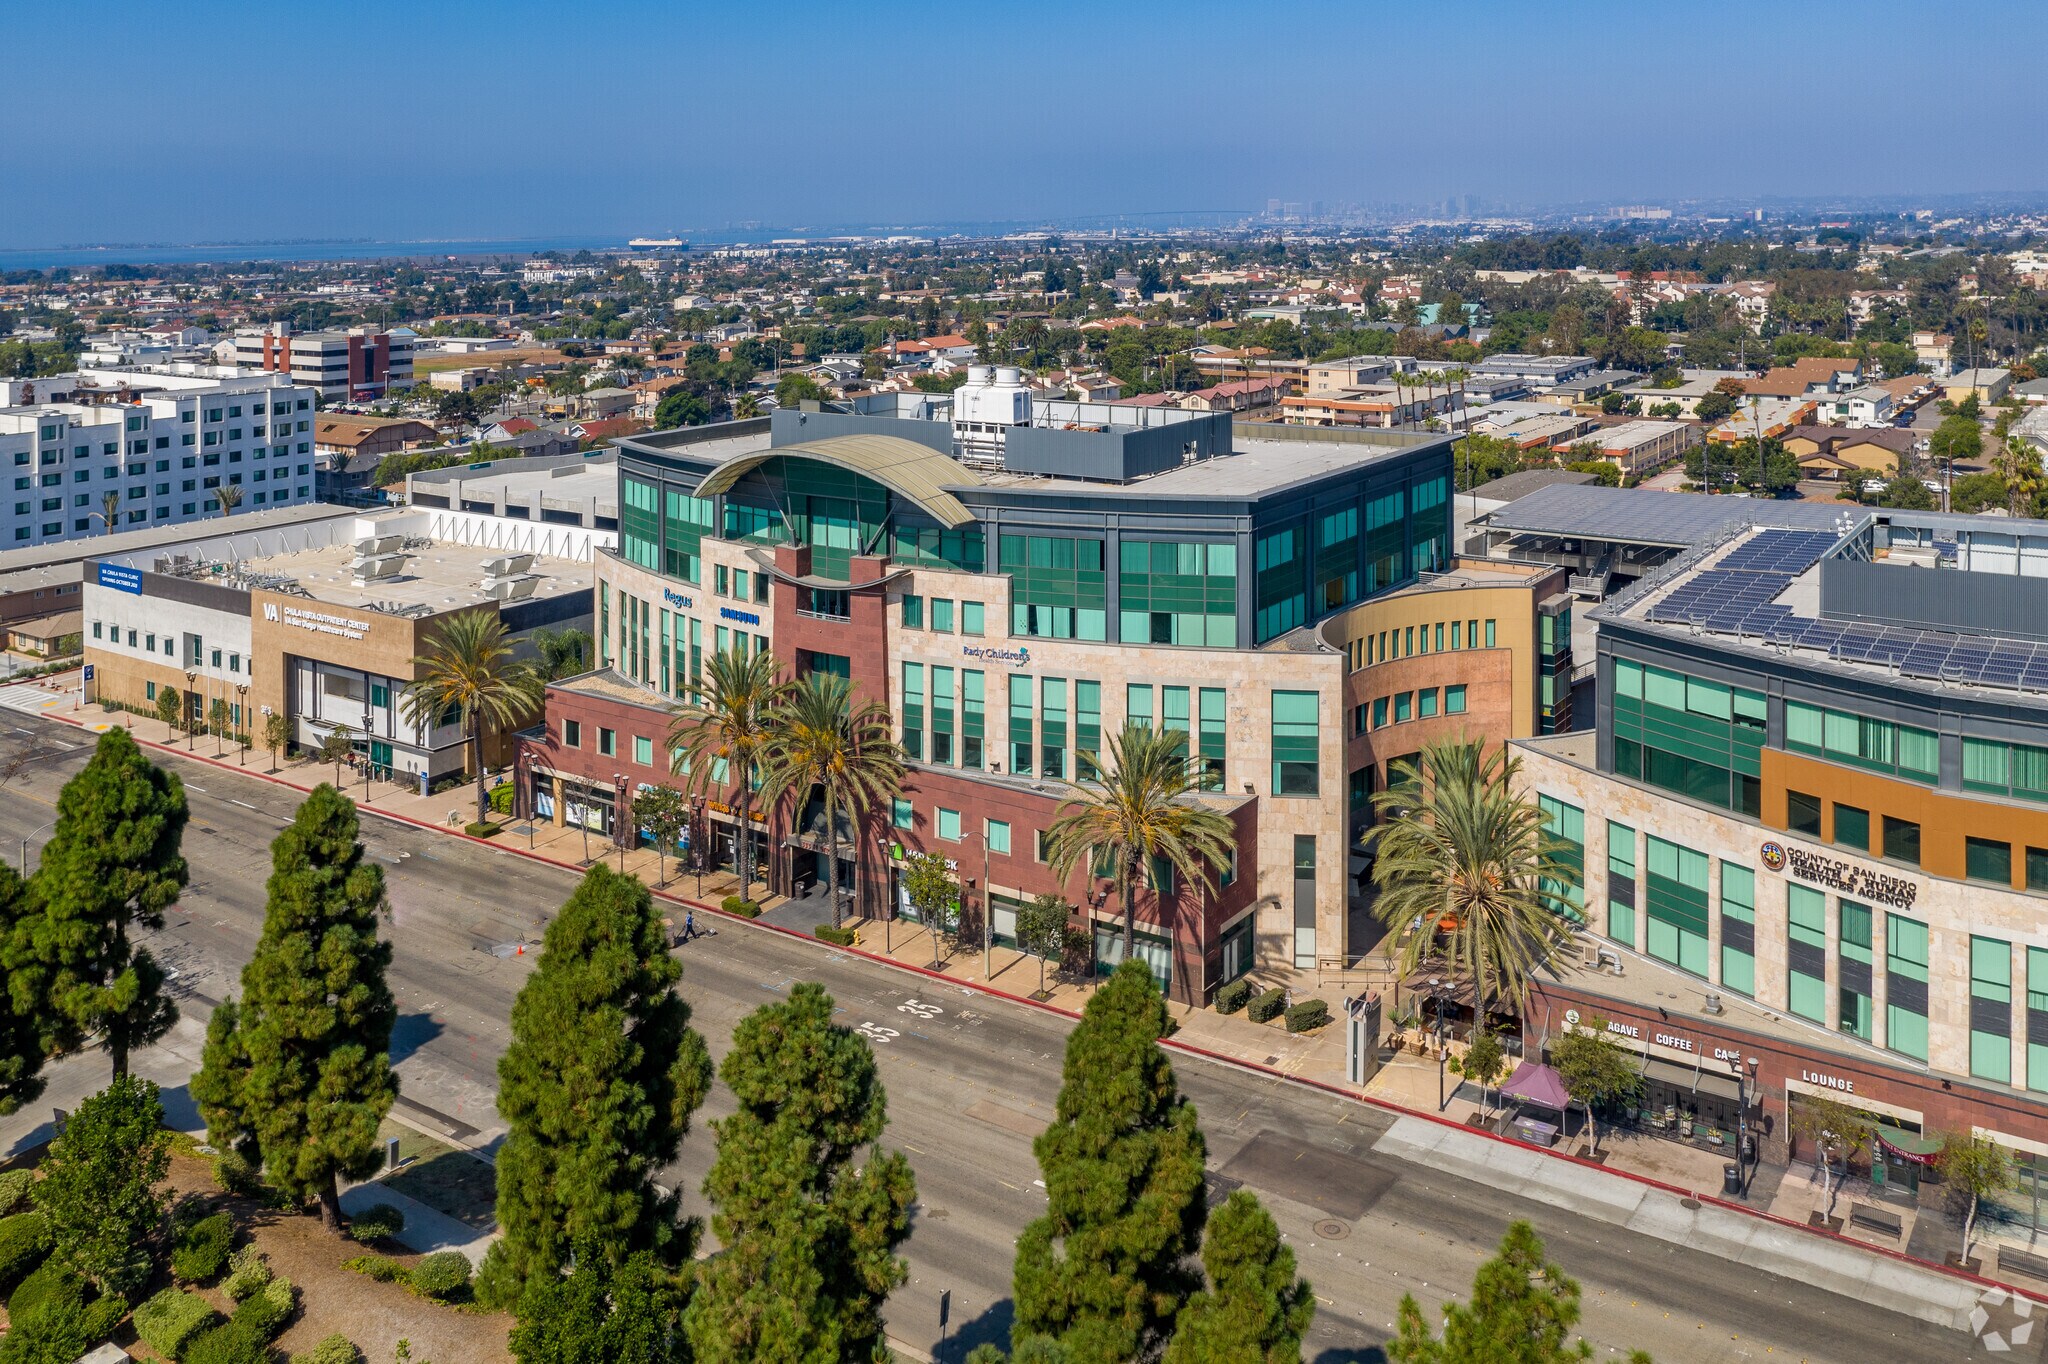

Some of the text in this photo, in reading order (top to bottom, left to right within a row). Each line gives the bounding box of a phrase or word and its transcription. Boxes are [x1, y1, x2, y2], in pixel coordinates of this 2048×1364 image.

[664, 586, 693, 609] Regus
[263, 602, 279, 622] VA
[284, 606, 370, 632] CHULA VISTA OUTPATIENT CENTER
[720, 606, 760, 627] SAMSUNG
[963, 645, 985, 659] Rady
[1787, 847, 1917, 892] COUNTY OF SAN DIEGO
[1789, 856, 1917, 902] HEALTH & HUMAN
[1793, 867, 1913, 911] SERVICES AGENCY
[897, 999, 944, 1019] 35
[854, 1021, 901, 1043] 35
[1607, 1021, 1741, 1064] AGAVE COFFEE CAÉ
[1802, 1069, 1854, 1093] LOUNGE
[1893, 1146, 1926, 1162] ENTRANCE
